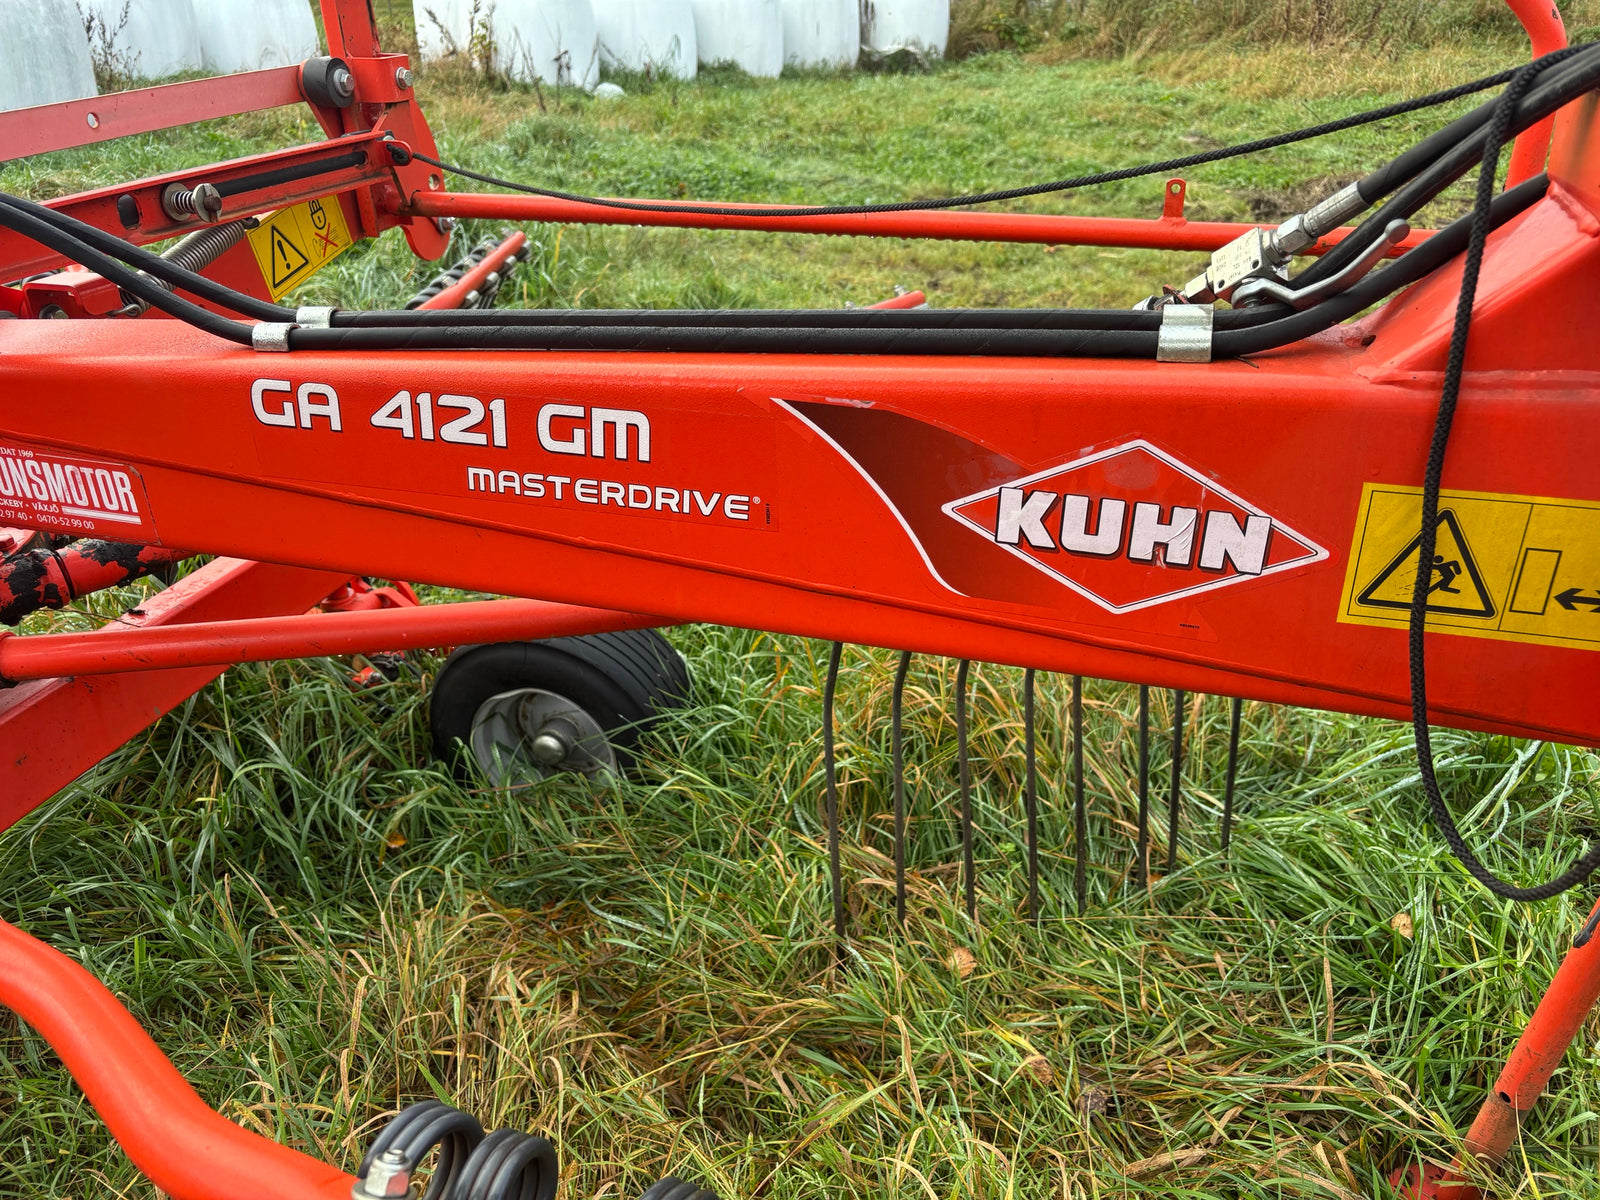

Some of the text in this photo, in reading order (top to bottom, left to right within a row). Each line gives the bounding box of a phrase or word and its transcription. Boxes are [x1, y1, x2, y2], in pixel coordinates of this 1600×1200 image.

[250, 377, 651, 462] GA 4121 GM
[17, 449, 34, 459] 1969
[5, 509, 15, 519] 97
[17, 511, 28, 521] 40
[36, 513, 71, 527] 0470-52
[71, 518, 82, 528] 99
[83, 520, 95, 530] 00
[994, 486, 1273, 575] KUHN
